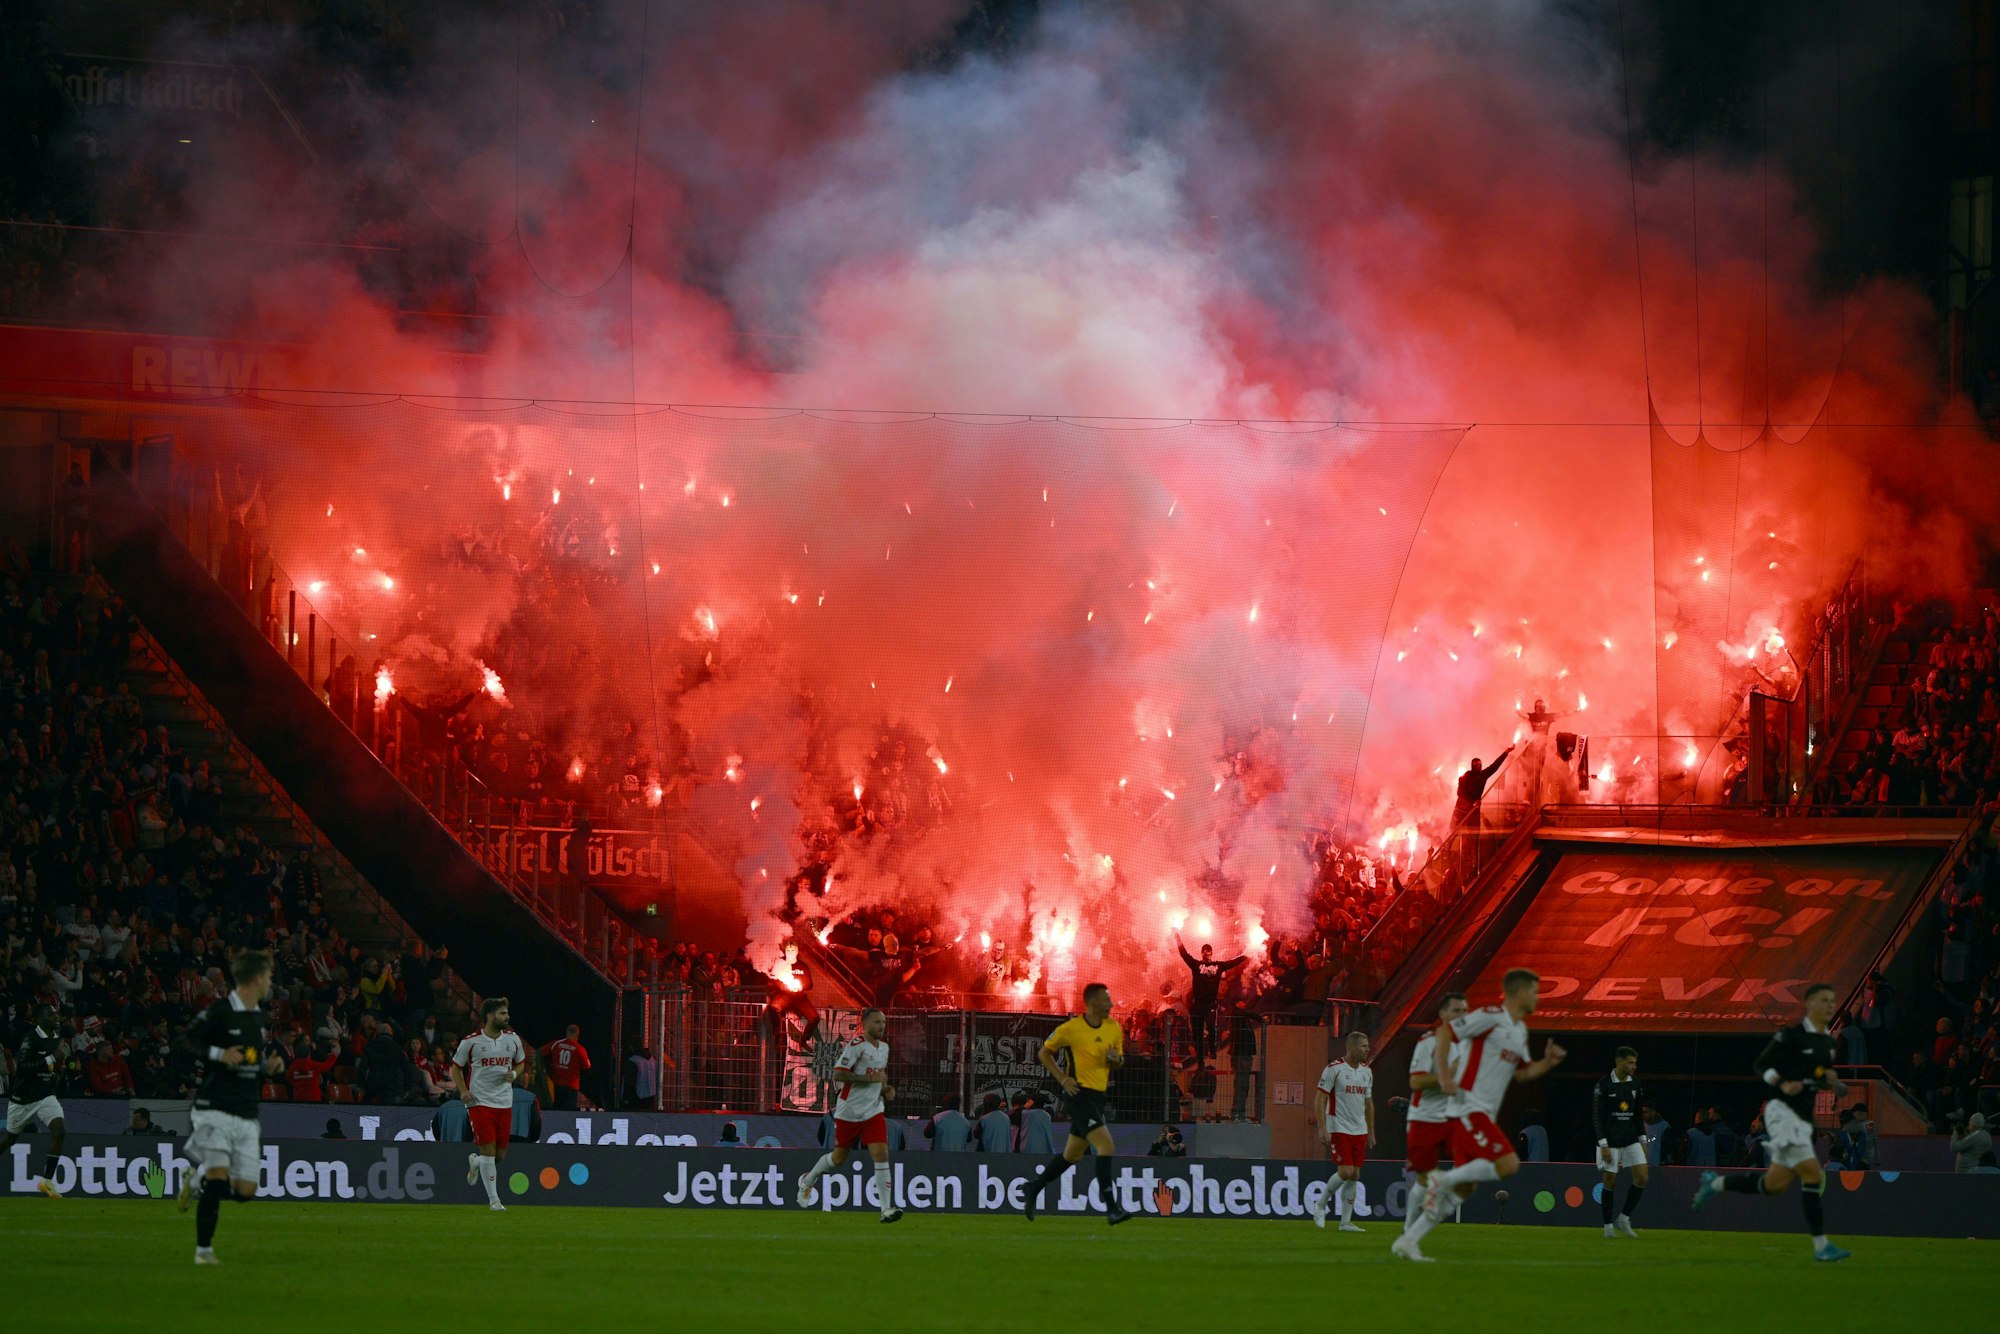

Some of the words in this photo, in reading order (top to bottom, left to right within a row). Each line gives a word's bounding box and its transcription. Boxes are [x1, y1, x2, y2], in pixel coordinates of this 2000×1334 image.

[1562, 870, 1774, 896] Come
[1784, 876, 1895, 900] on,
[1583, 904, 1836, 949] FC!
[1584, 1010, 1662, 1018] Getan.
[481, 1057, 511, 1067] REWE
[559, 1049, 571, 1066] 10
[10, 1143, 436, 1200] Lottohden.de
[663, 1161, 785, 1206] Jetzt
[977, 1164, 1046, 1211] bei
[1057, 1163, 1417, 1218] Lottohelden.d
